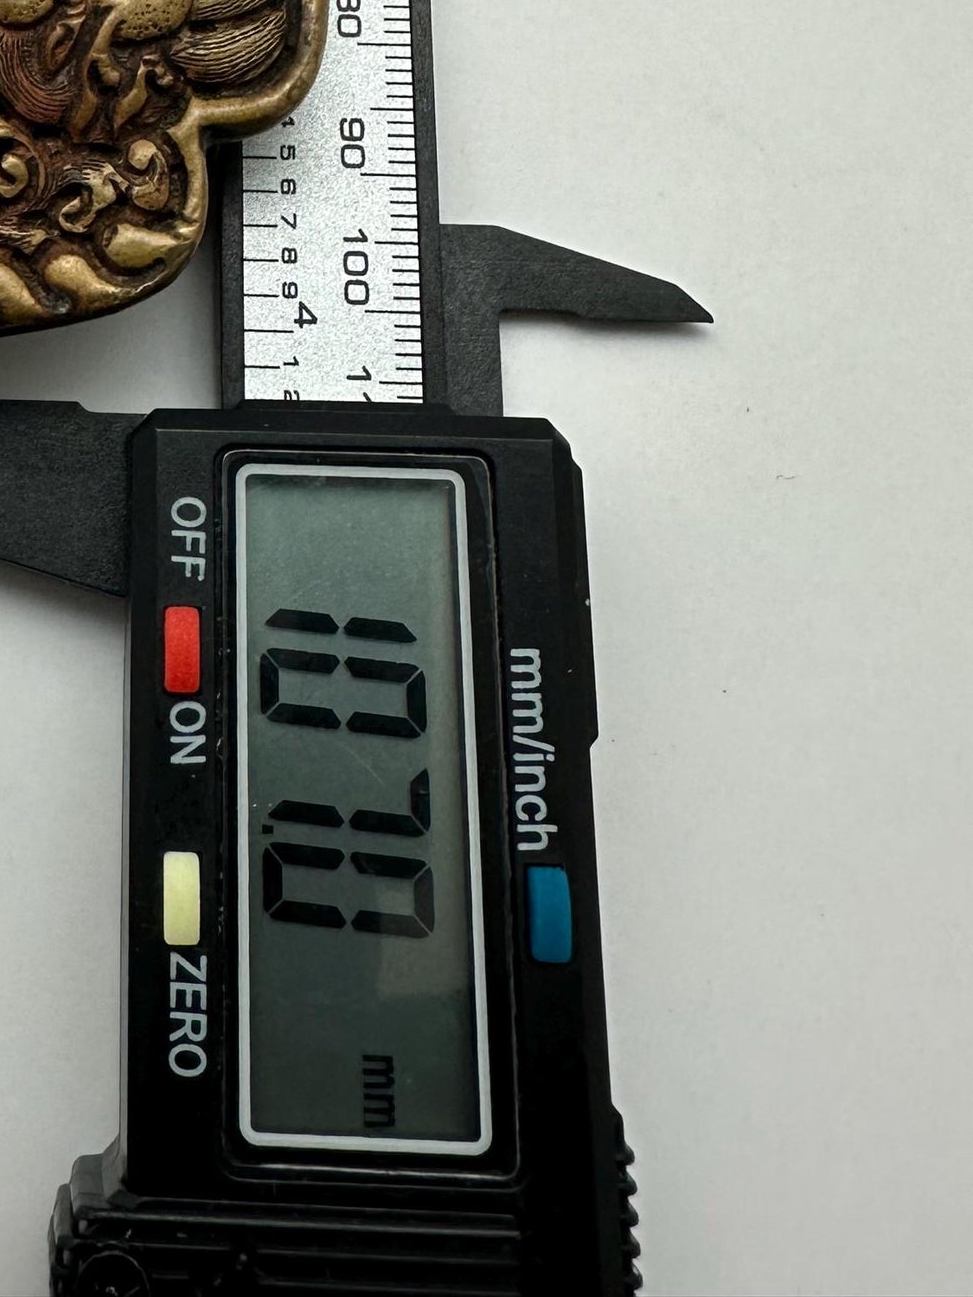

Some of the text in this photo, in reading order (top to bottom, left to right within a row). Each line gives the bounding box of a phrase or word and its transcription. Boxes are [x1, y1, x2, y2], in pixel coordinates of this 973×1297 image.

[279, 144, 296, 161] 5
[339, 117, 365, 169] 90
[280, 178, 297, 195] 6
[280, 212, 297, 230] 7
[281, 247, 298, 264] 8
[342, 228, 370, 306] 100
[282, 281, 299, 299] 9
[293, 301, 318, 329] 4
[283, 355, 300, 367] 1
[170, 496, 207, 582] OFF
[169, 700, 207, 765] ON
[510, 648, 559, 852] mm/inch
[260, 607, 435, 1128] 107.0 mm
[168, 951, 208, 1078] ZERO
